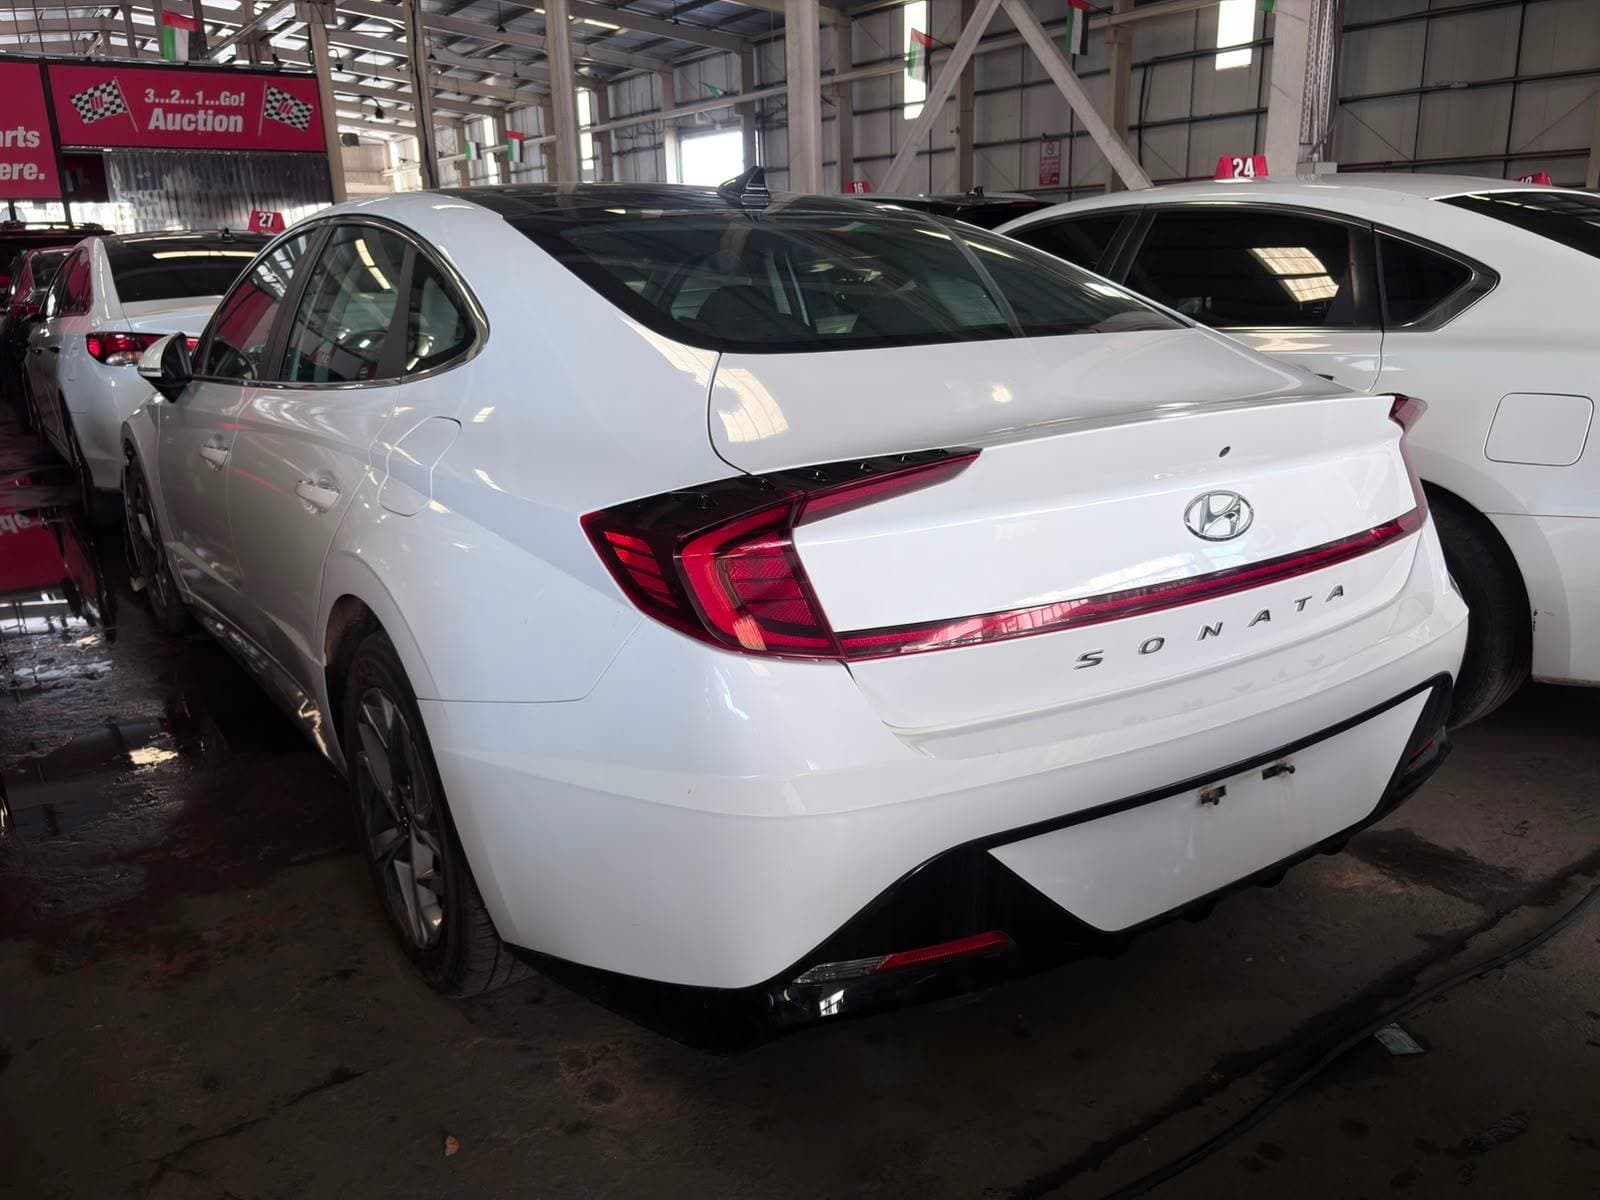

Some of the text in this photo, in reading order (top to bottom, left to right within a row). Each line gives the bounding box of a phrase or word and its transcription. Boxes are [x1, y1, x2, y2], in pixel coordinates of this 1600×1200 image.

[144, 88, 245, 106] 3...2...1...Go!
[148, 107, 243, 132] Auction
[0, 126, 40, 148] rts
[1232, 157, 1255, 178] 24
[853, 182, 864, 194] 16
[259, 212, 274, 228] 27
[1073, 584, 1344, 670] SONATA
